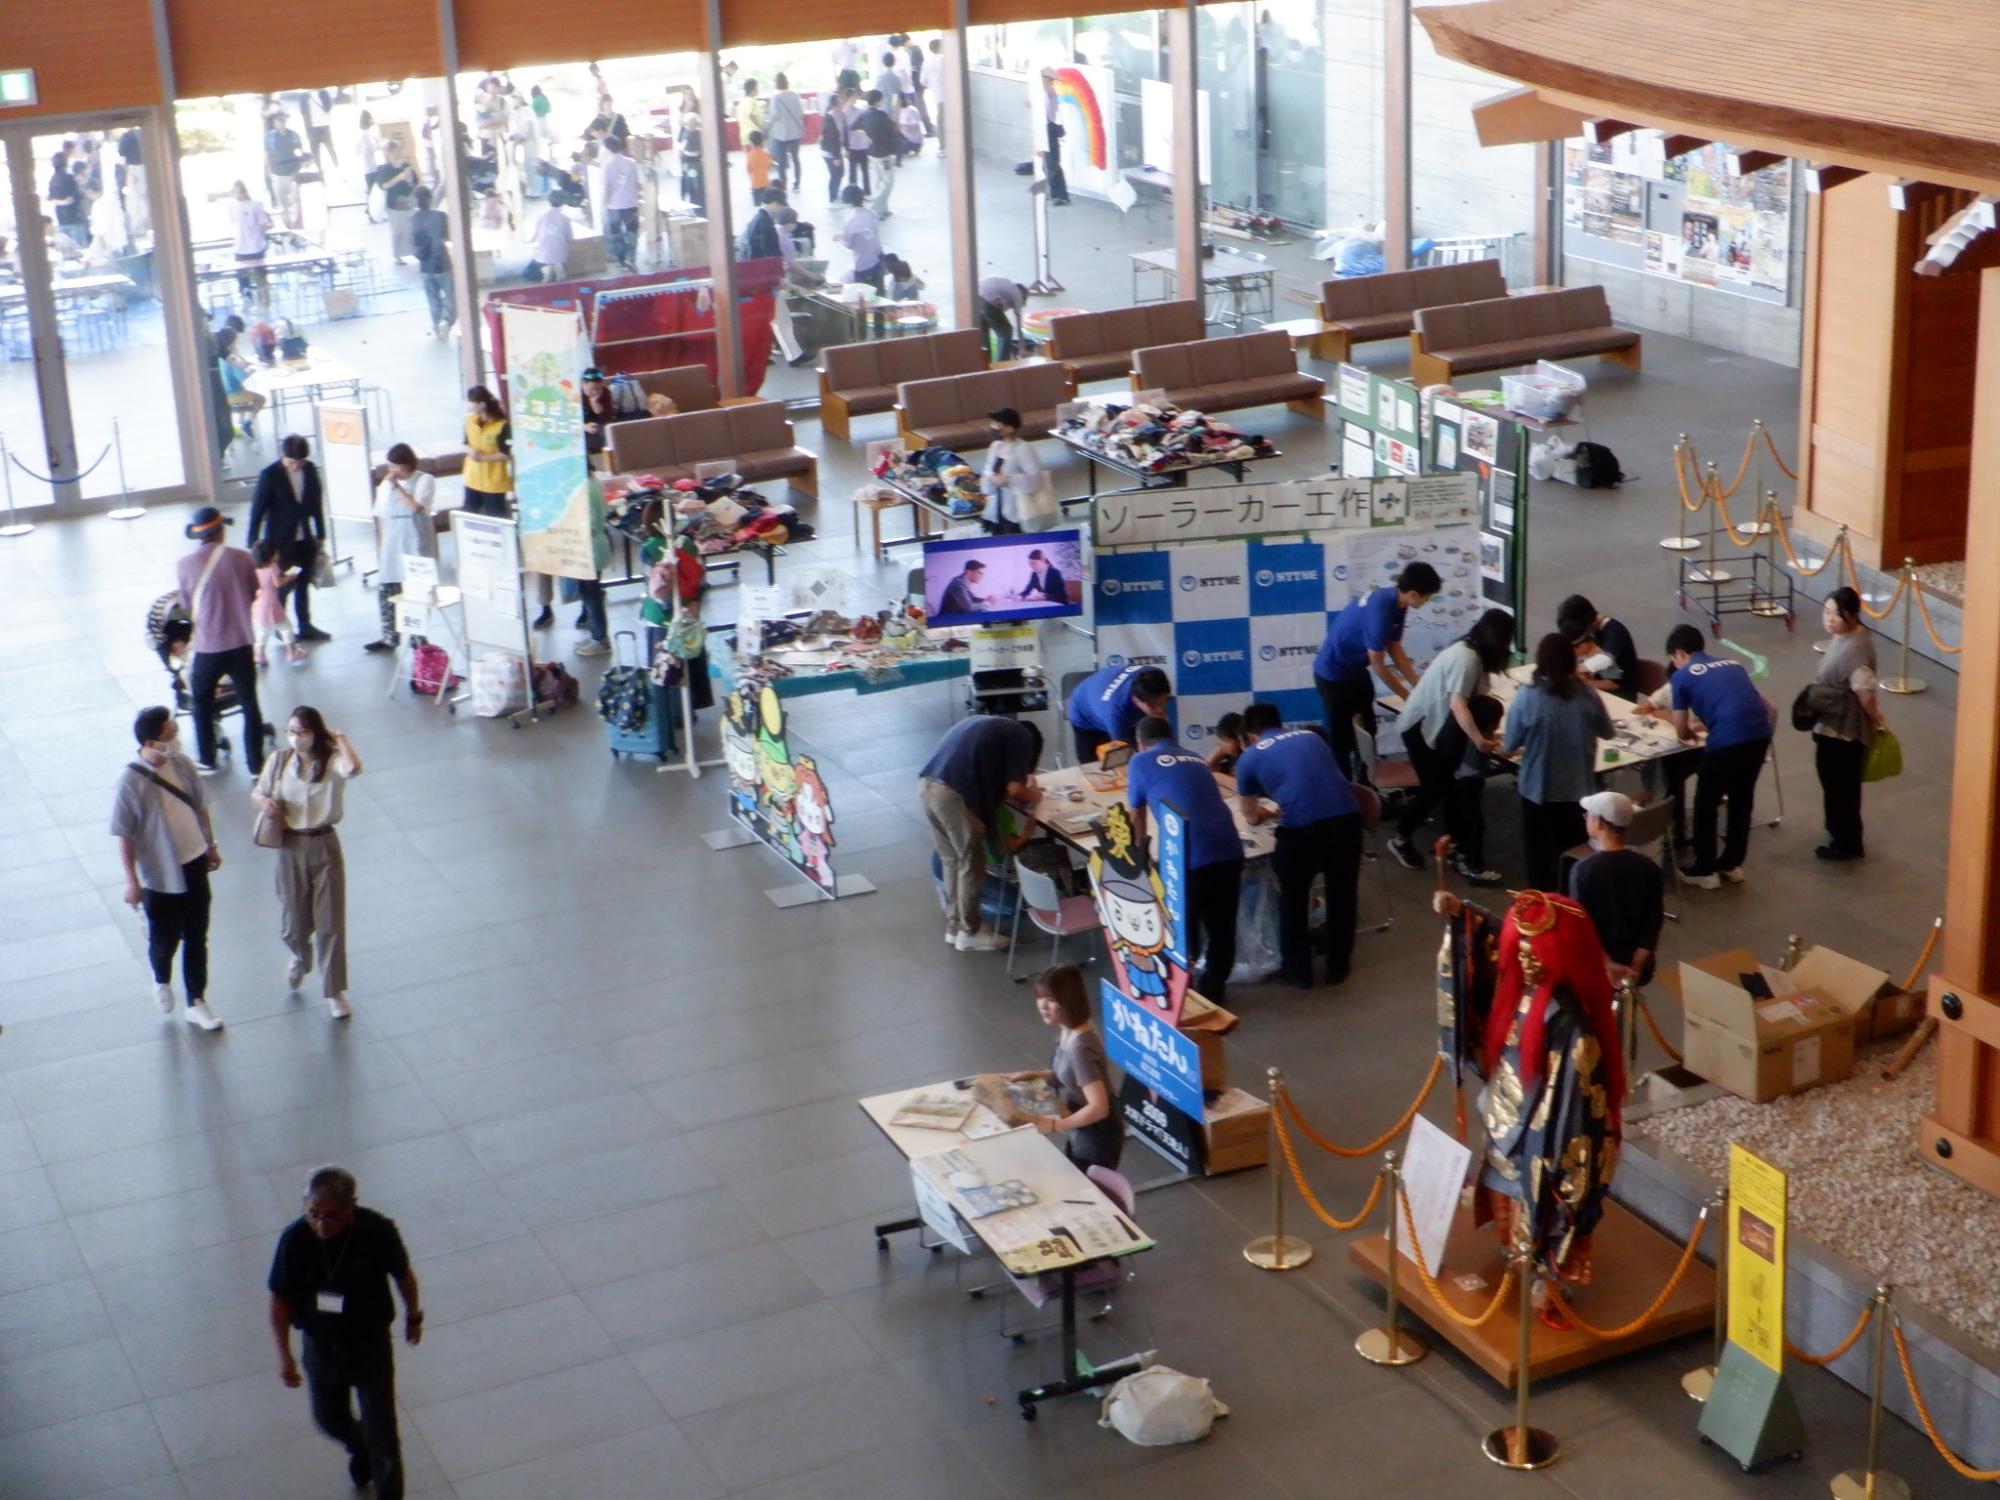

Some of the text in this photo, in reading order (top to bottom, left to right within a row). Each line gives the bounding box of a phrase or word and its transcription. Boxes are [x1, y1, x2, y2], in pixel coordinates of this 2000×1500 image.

[1103, 487, 1370, 534] ソーラーカー工作
